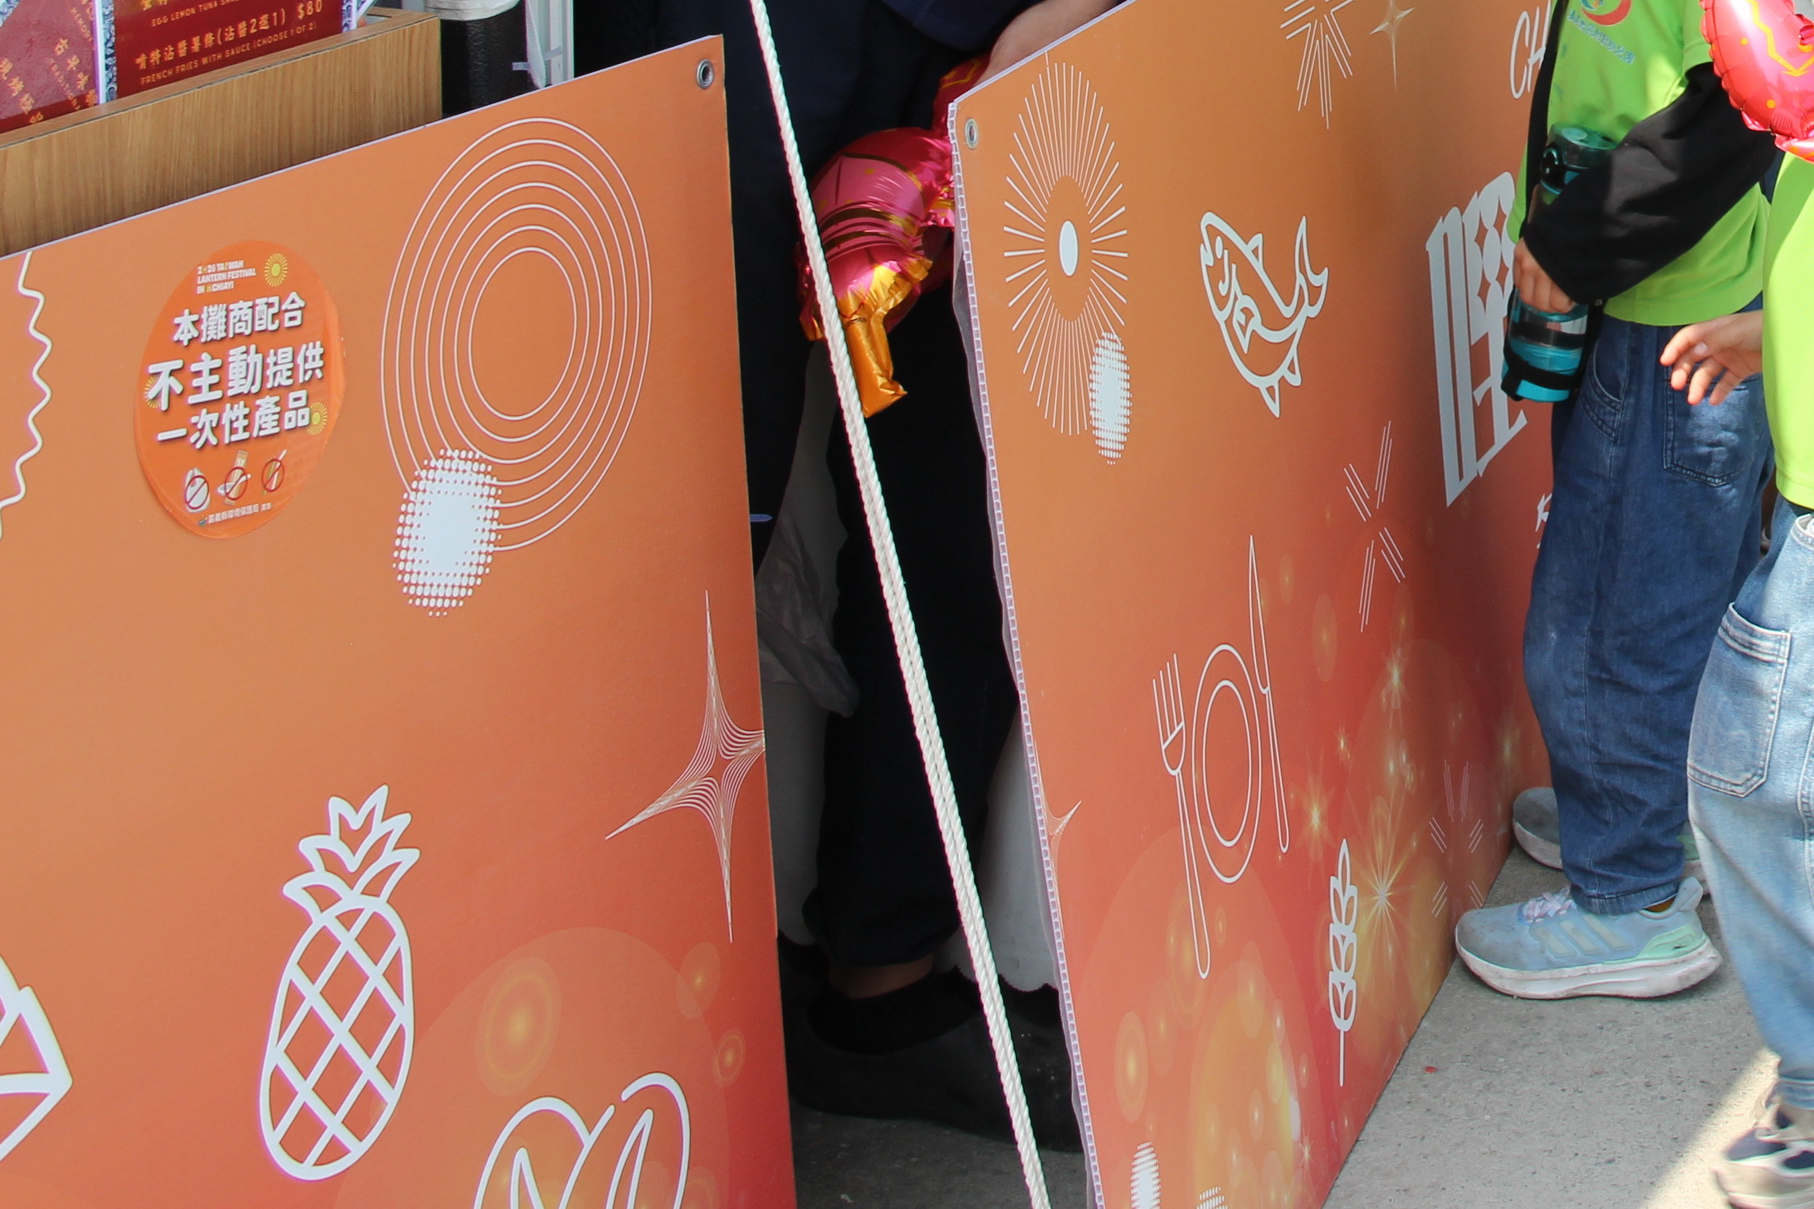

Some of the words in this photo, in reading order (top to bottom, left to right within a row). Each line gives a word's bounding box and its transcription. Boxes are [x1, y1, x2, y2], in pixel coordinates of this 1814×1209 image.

[152, 15, 168, 27] EGG
[171, 7, 196, 22] LEMON
[198, 1, 218, 13] TUNA
[140, 69, 173, 85] FRENCH
[175, 61, 199, 74] FRIES
[201, 53, 222, 66] WITH
[225, 43, 251, 58] SAUCE
[173, 291, 306, 347] 本攤商配合
[148, 340, 325, 411] 不主動提供
[157, 389, 311, 450] 一次性產品
